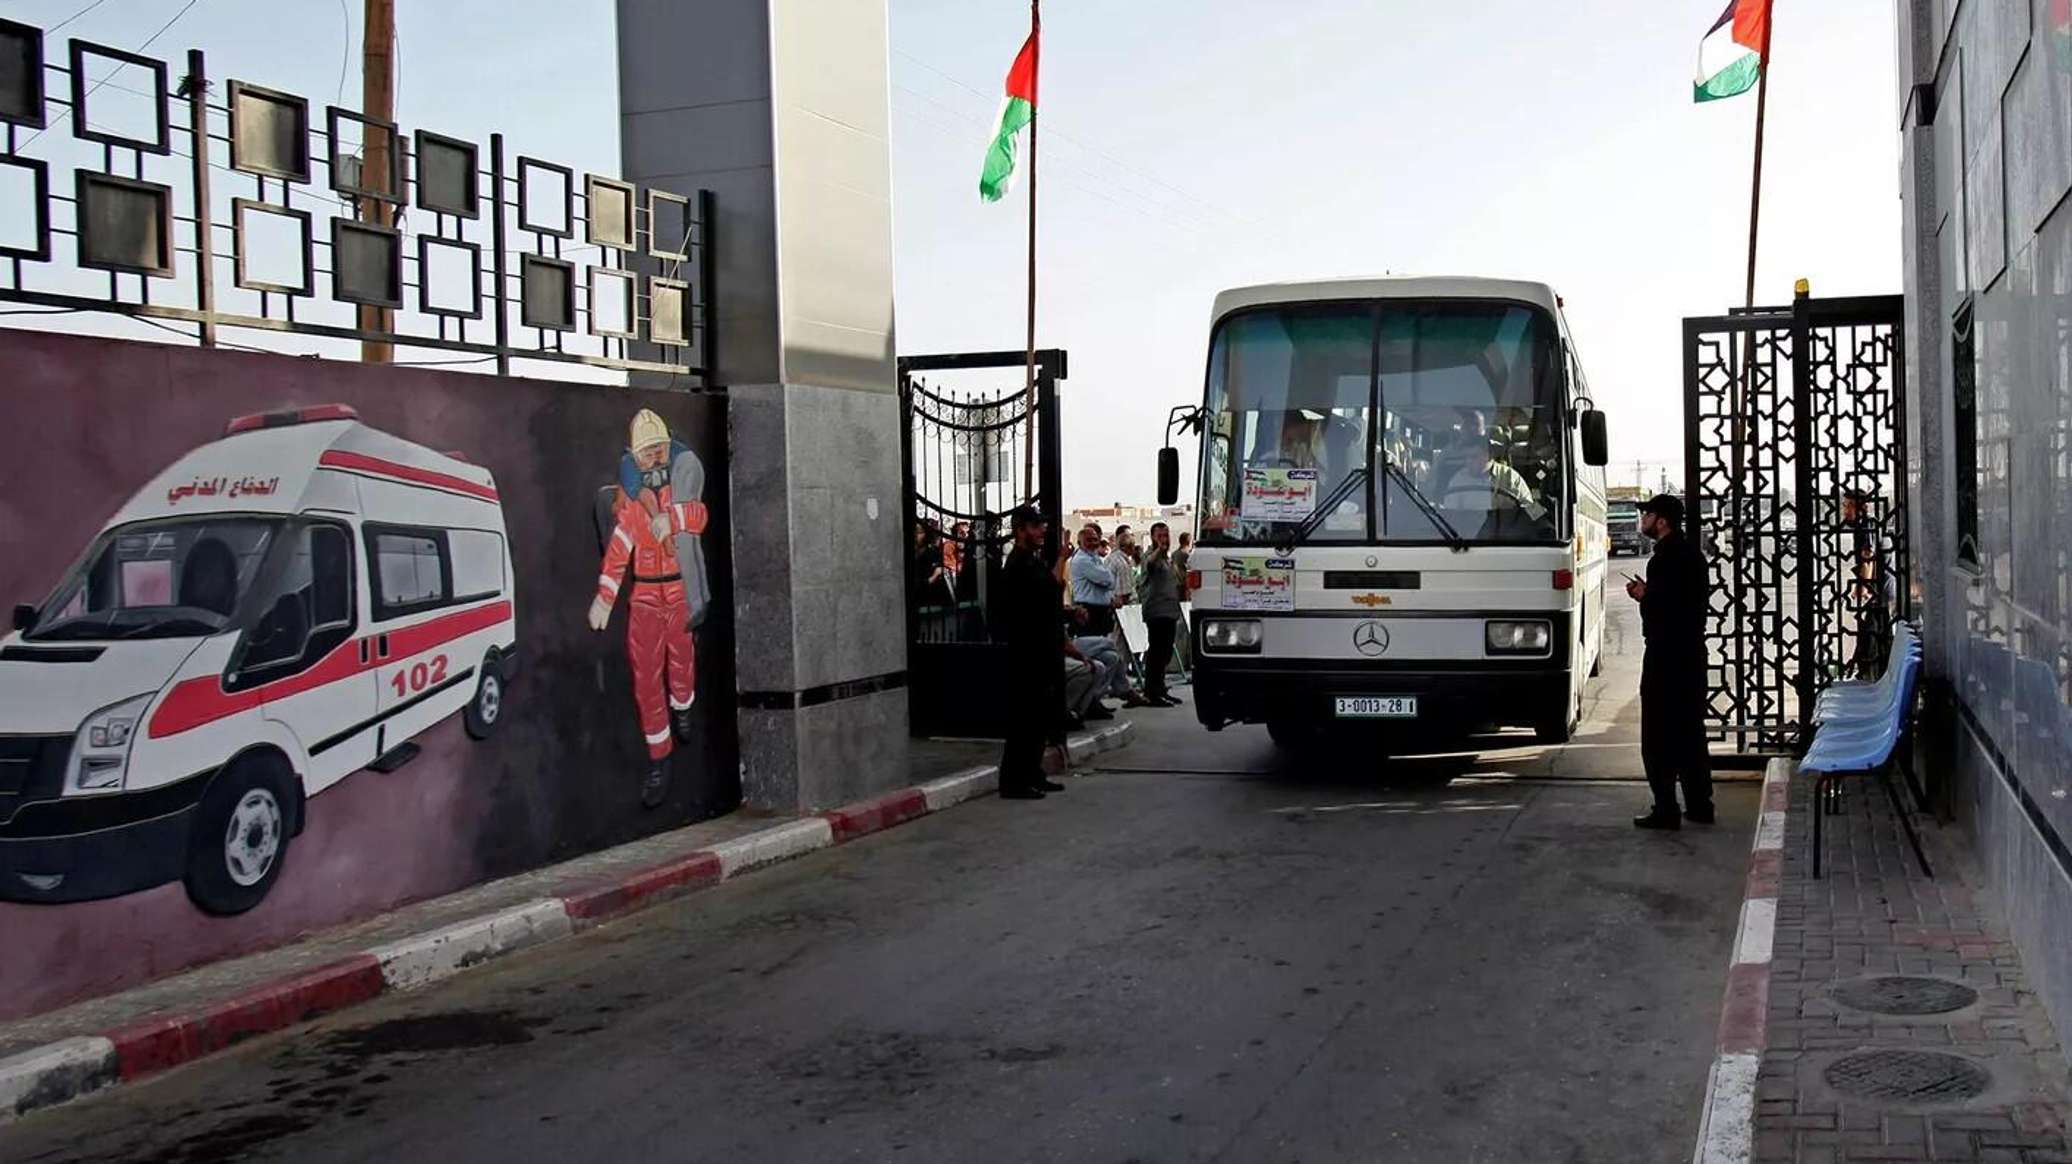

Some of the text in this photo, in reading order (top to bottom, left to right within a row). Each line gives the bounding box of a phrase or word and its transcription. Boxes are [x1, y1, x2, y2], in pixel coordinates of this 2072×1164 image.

[167, 476, 280, 505] الدفاع المدني
[391, 653, 449, 697] 102
[1338, 699, 1402, 713] 3-0013-28
